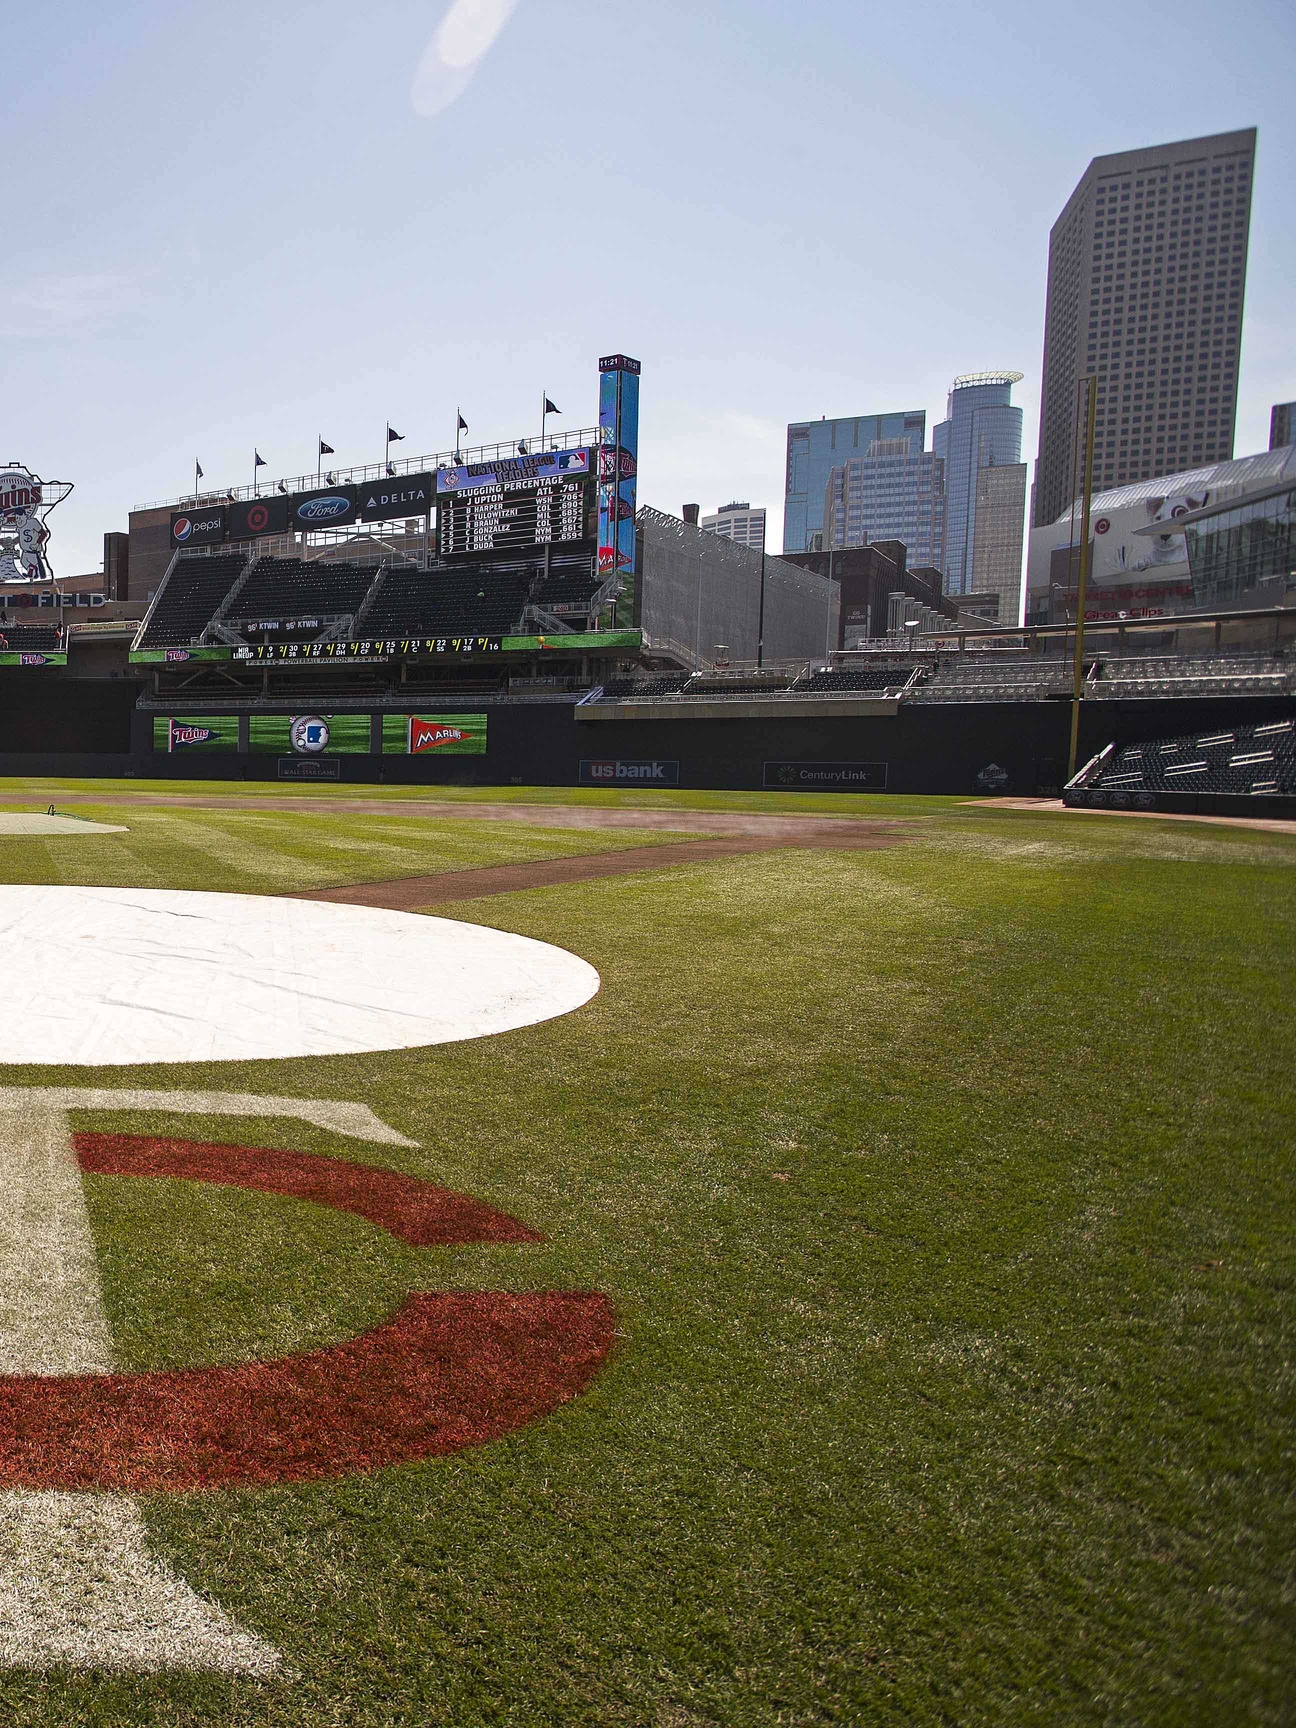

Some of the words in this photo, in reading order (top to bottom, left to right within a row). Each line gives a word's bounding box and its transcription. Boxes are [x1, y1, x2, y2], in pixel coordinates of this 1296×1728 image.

[600, 358, 618, 367] 11:21
[467, 461, 521, 477] NATIONAL
[522, 455, 555, 468] LEAGUE
[496, 467, 539, 482] LEADERS
[457, 483, 502, 498] SLUGGING
[505, 476, 564, 491] PERCENTAGE
[474, 494, 504, 504] UPTON
[537, 488, 553, 496] ATL
[559, 484, 578, 492] .761
[381, 490, 425, 505] DELTA
[474, 503, 503, 513] HARPER
[559, 494, 577, 502] .706
[307, 501, 339, 517] Ford
[474, 509, 518, 520] TULOWITZKI
[192, 517, 221, 533] pepsi
[474, 519, 499, 527] BRAUN
[559, 509, 577, 517] .685
[474, 524, 510, 535] GONZALEZ
[559, 517, 577, 525] .667
[474, 534, 493, 542] BUCK
[535, 527, 551, 535] NYM
[474, 541, 494, 550] DUDA
[535, 535, 551, 543] NYM
[558, 532, 577, 540] .659
[38, 593, 106, 608] FIELD
[1085, 610, 1125, 619] Grea
[1130, 607, 1164, 618] Clips
[172, 727, 209, 743] Twins
[416, 729, 462, 748] MARLINS
[799, 769, 867, 781] CenturyLink
